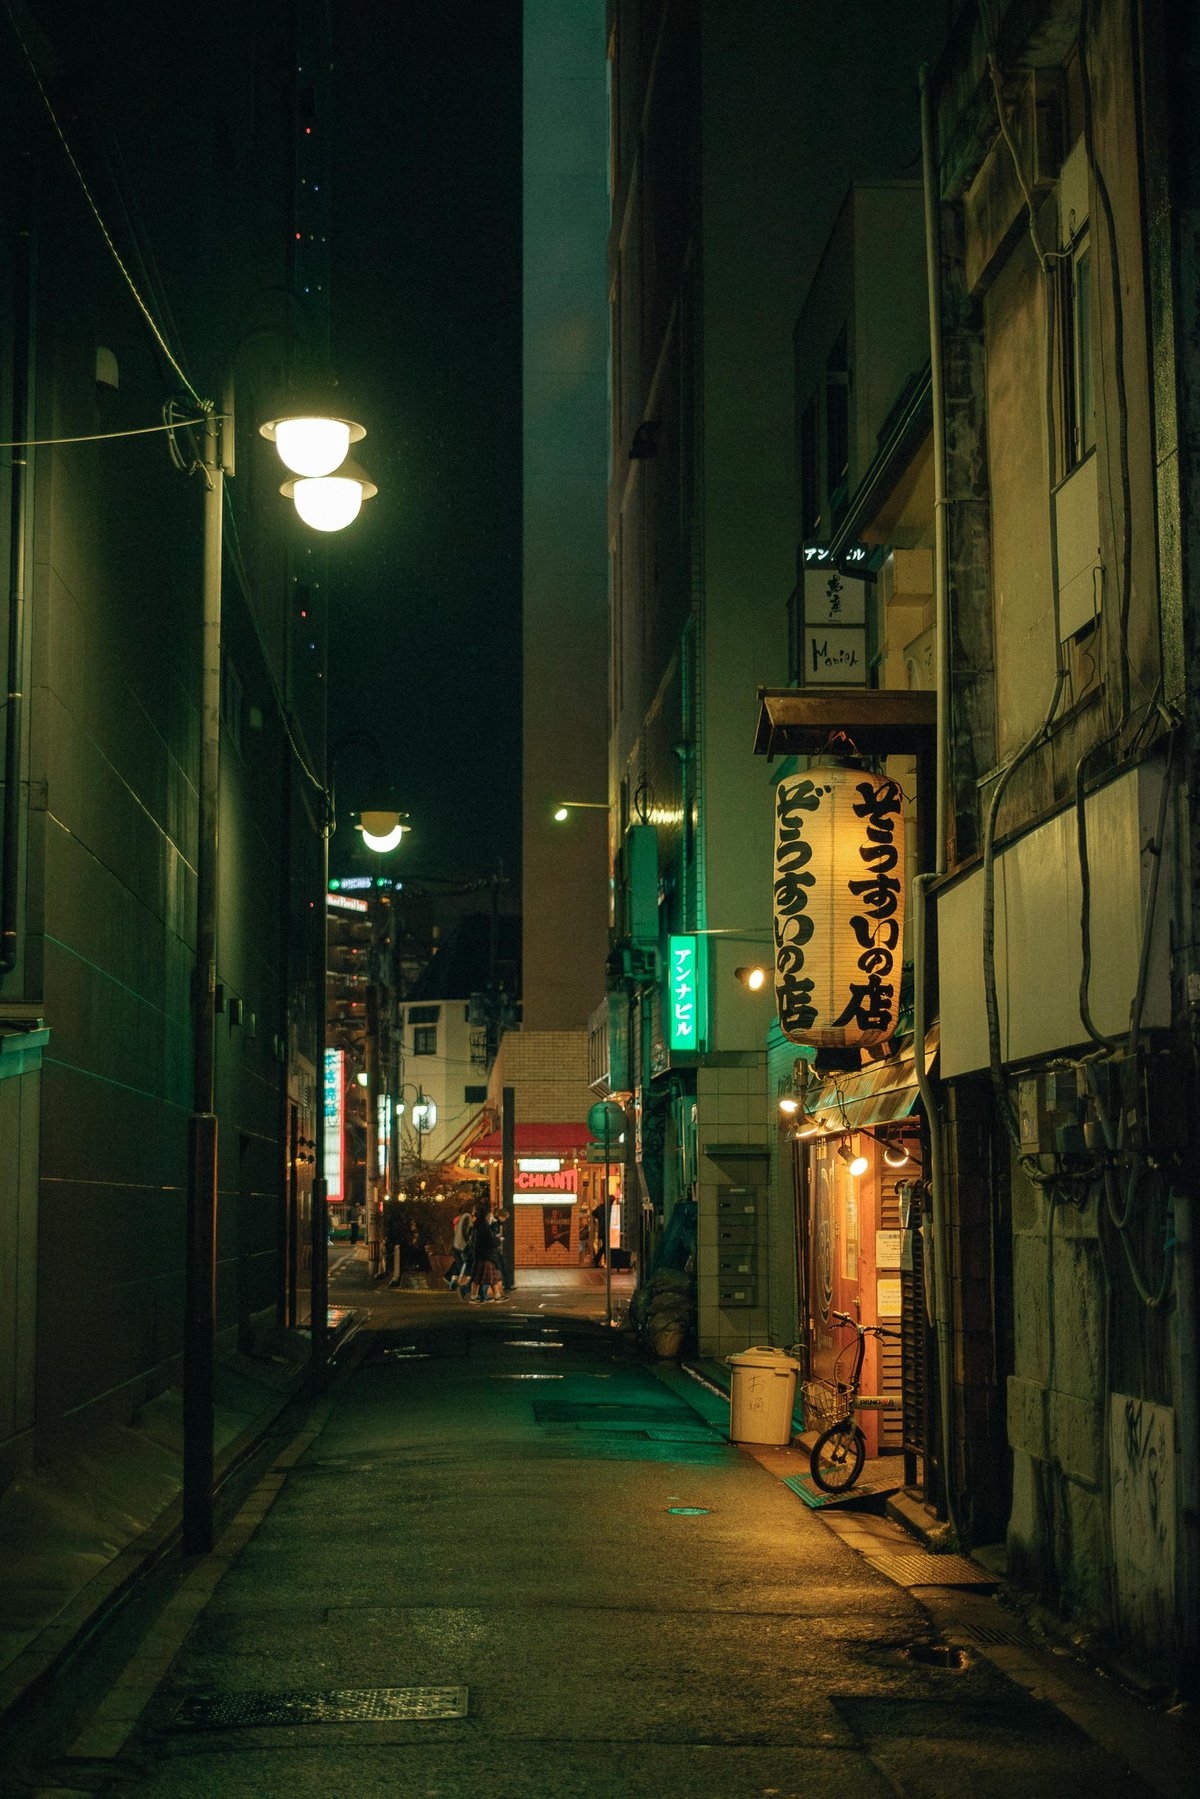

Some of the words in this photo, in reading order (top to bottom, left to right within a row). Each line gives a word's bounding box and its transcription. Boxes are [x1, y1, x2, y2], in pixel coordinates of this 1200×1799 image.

[774, 779, 831, 1030] ぞうすいの店
[674, 949, 693, 1037] アンナビル
